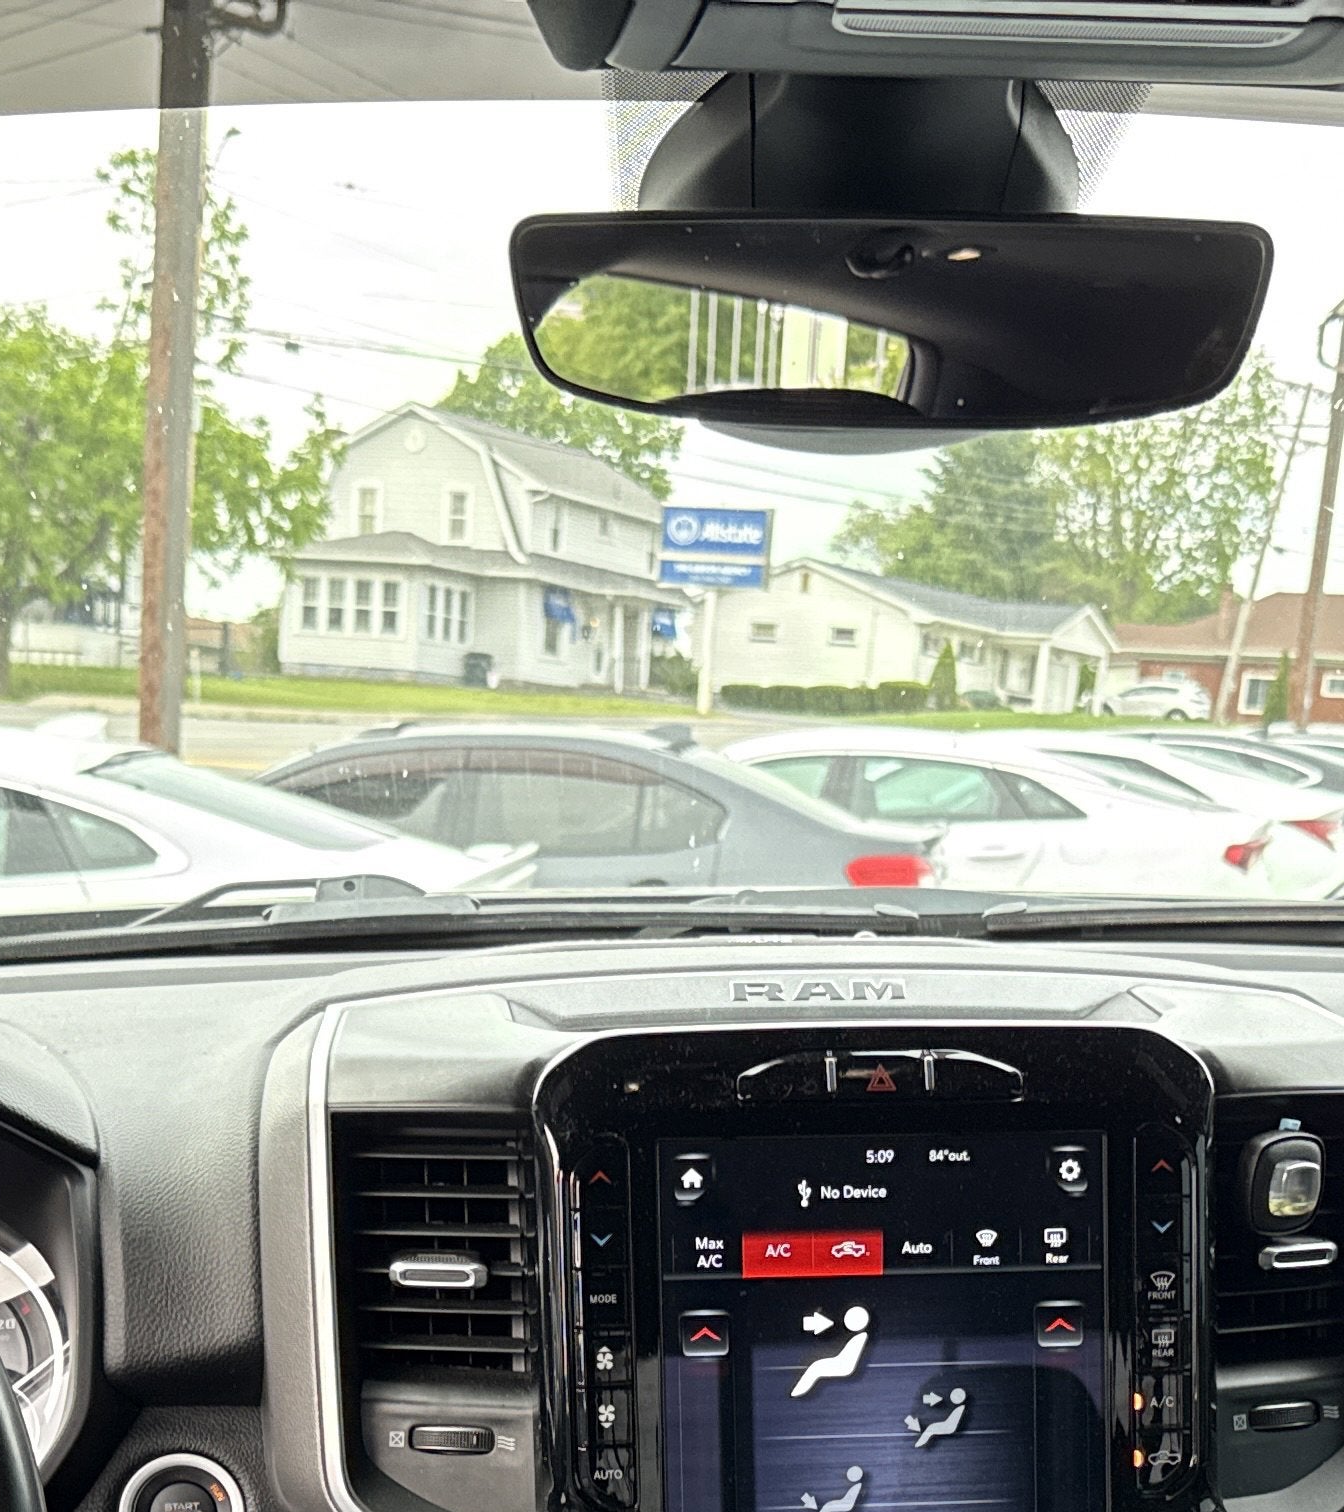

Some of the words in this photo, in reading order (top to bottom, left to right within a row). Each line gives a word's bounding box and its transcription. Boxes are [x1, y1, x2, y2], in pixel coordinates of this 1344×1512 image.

[729, 979, 906, 1002] RAM
[865, 1149, 894, 1165] 5:09
[820, 1185, 838, 1200] No
[841, 1184, 887, 1200] Device
[695, 1236, 724, 1251] Max
[901, 1240, 933, 1255] Auto
[764, 1243, 791, 1259] A/C
[1045, 1252, 1069, 1264] Rear
[697, 1252, 723, 1269] A/C
[972, 1254, 1000, 1266] Front
[589, 1293, 617, 1304] MODE
[1146, 1290, 1176, 1300] FRONT
[1151, 1347, 1175, 1358] REAR
[1149, 1396, 1174, 1410] A/C
[593, 1468, 623, 1480] AUTO
[164, 1502, 200, 1511] START
